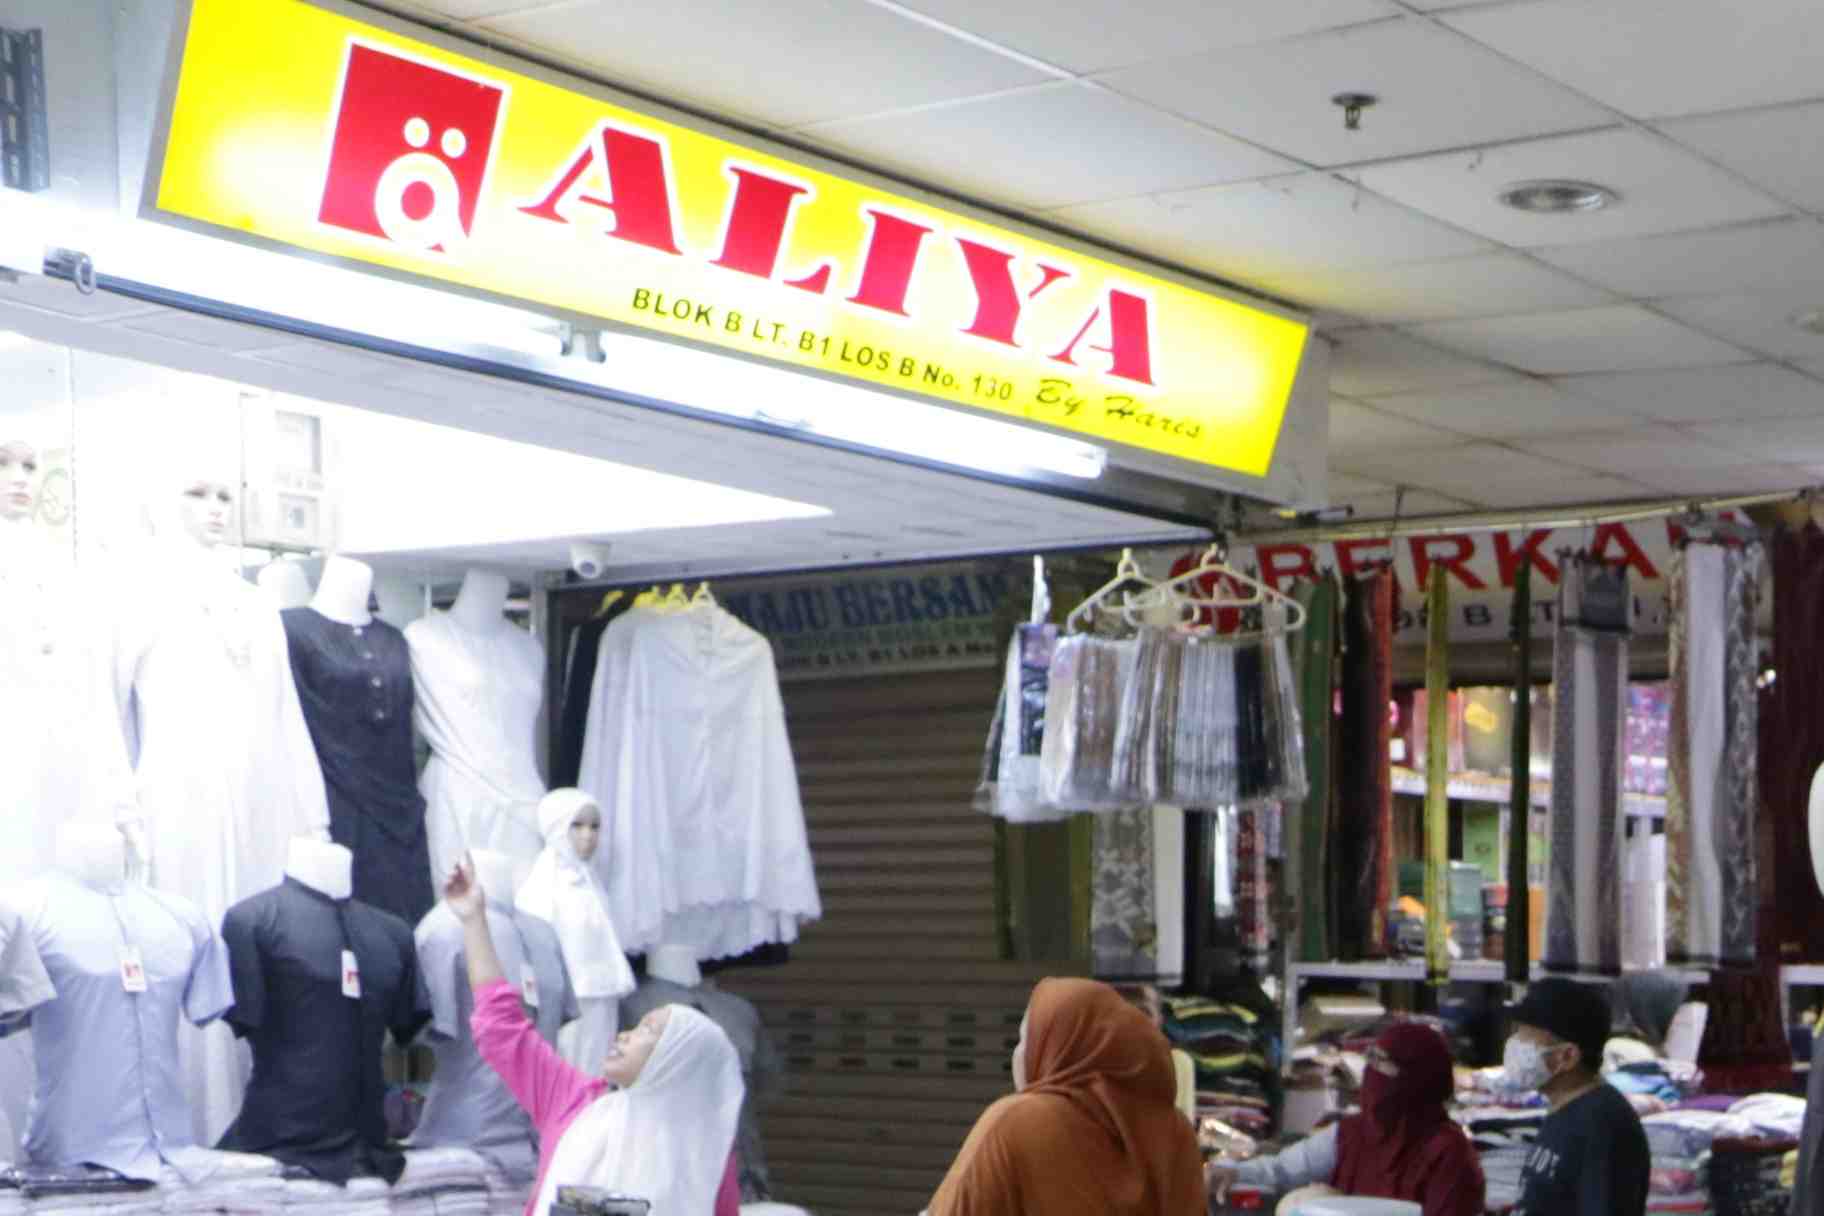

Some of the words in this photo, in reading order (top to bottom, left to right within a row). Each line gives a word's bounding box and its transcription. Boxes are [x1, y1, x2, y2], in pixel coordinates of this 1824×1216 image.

[516, 126, 1156, 386] ALIYA
[631, 287, 714, 327] BLOK
[723, 311, 742, 333] B
[752, 318, 788, 346] LT.
[798, 329, 831, 356] B1
[840, 341, 890, 371] LOS
[898, 356, 916, 378] B
[922, 363, 960, 390] No.
[973, 374, 1013, 401] 130
[1035, 378, 1085, 417] By
[1254, 511, 1744, 599] BERKA
